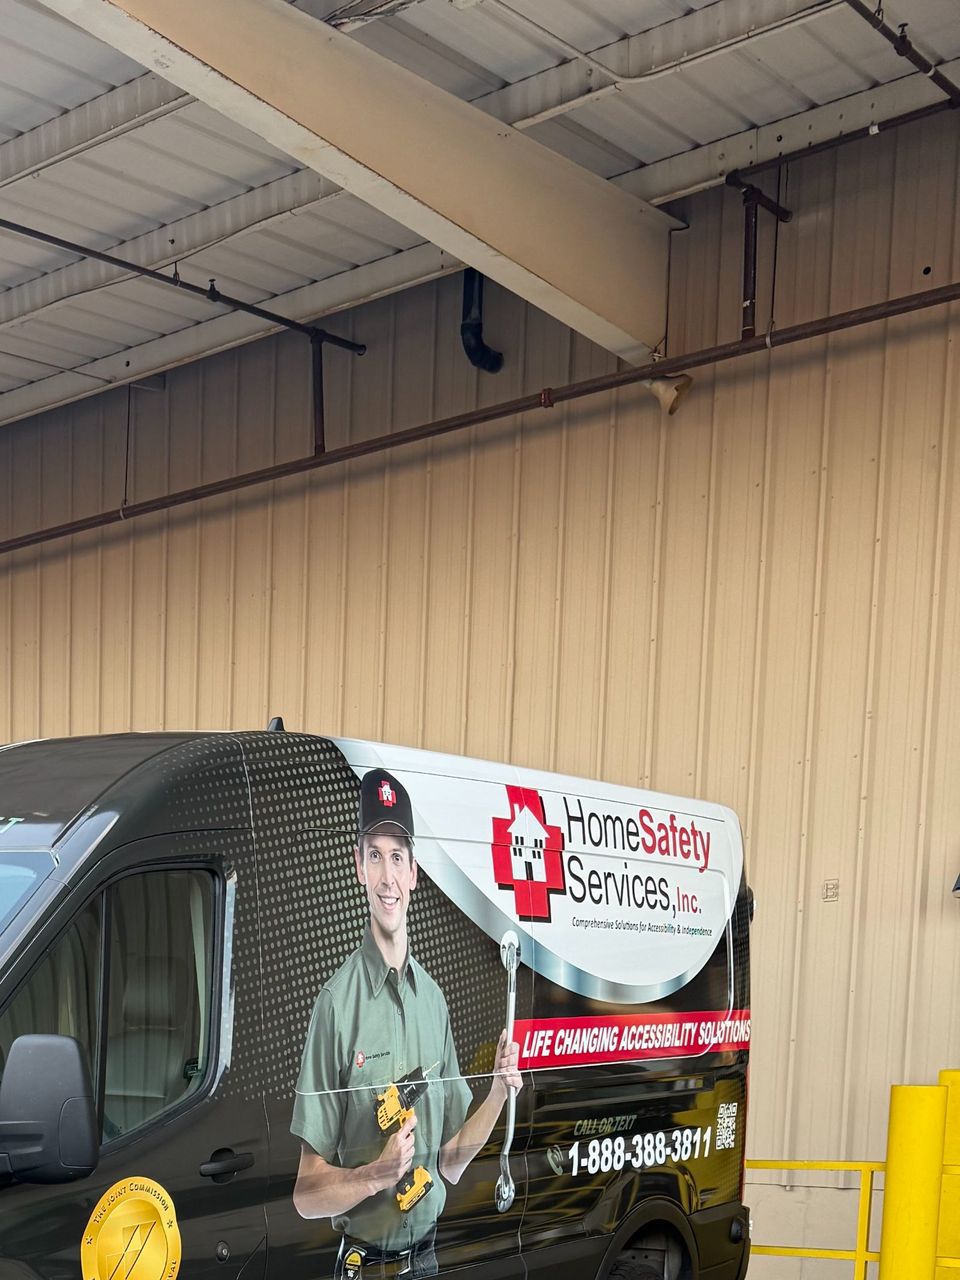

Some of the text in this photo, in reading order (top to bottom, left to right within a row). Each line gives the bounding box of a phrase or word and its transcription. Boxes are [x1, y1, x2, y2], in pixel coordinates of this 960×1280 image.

[563, 796, 711, 874] HomeSafety
[572, 916, 614, 929] Comprehensive
[615, 919, 639, 931] Solutions
[639, 921, 647, 933] for
[648, 922, 676, 935] Accessibility
[522, 1020, 751, 1058] LIFE CHANGING ACCESSIBILITY SOLUTIONS
[574, 1114, 637, 1136] CALL OR TEXT
[569, 1127, 712, 1177] 1-888-388-3811
